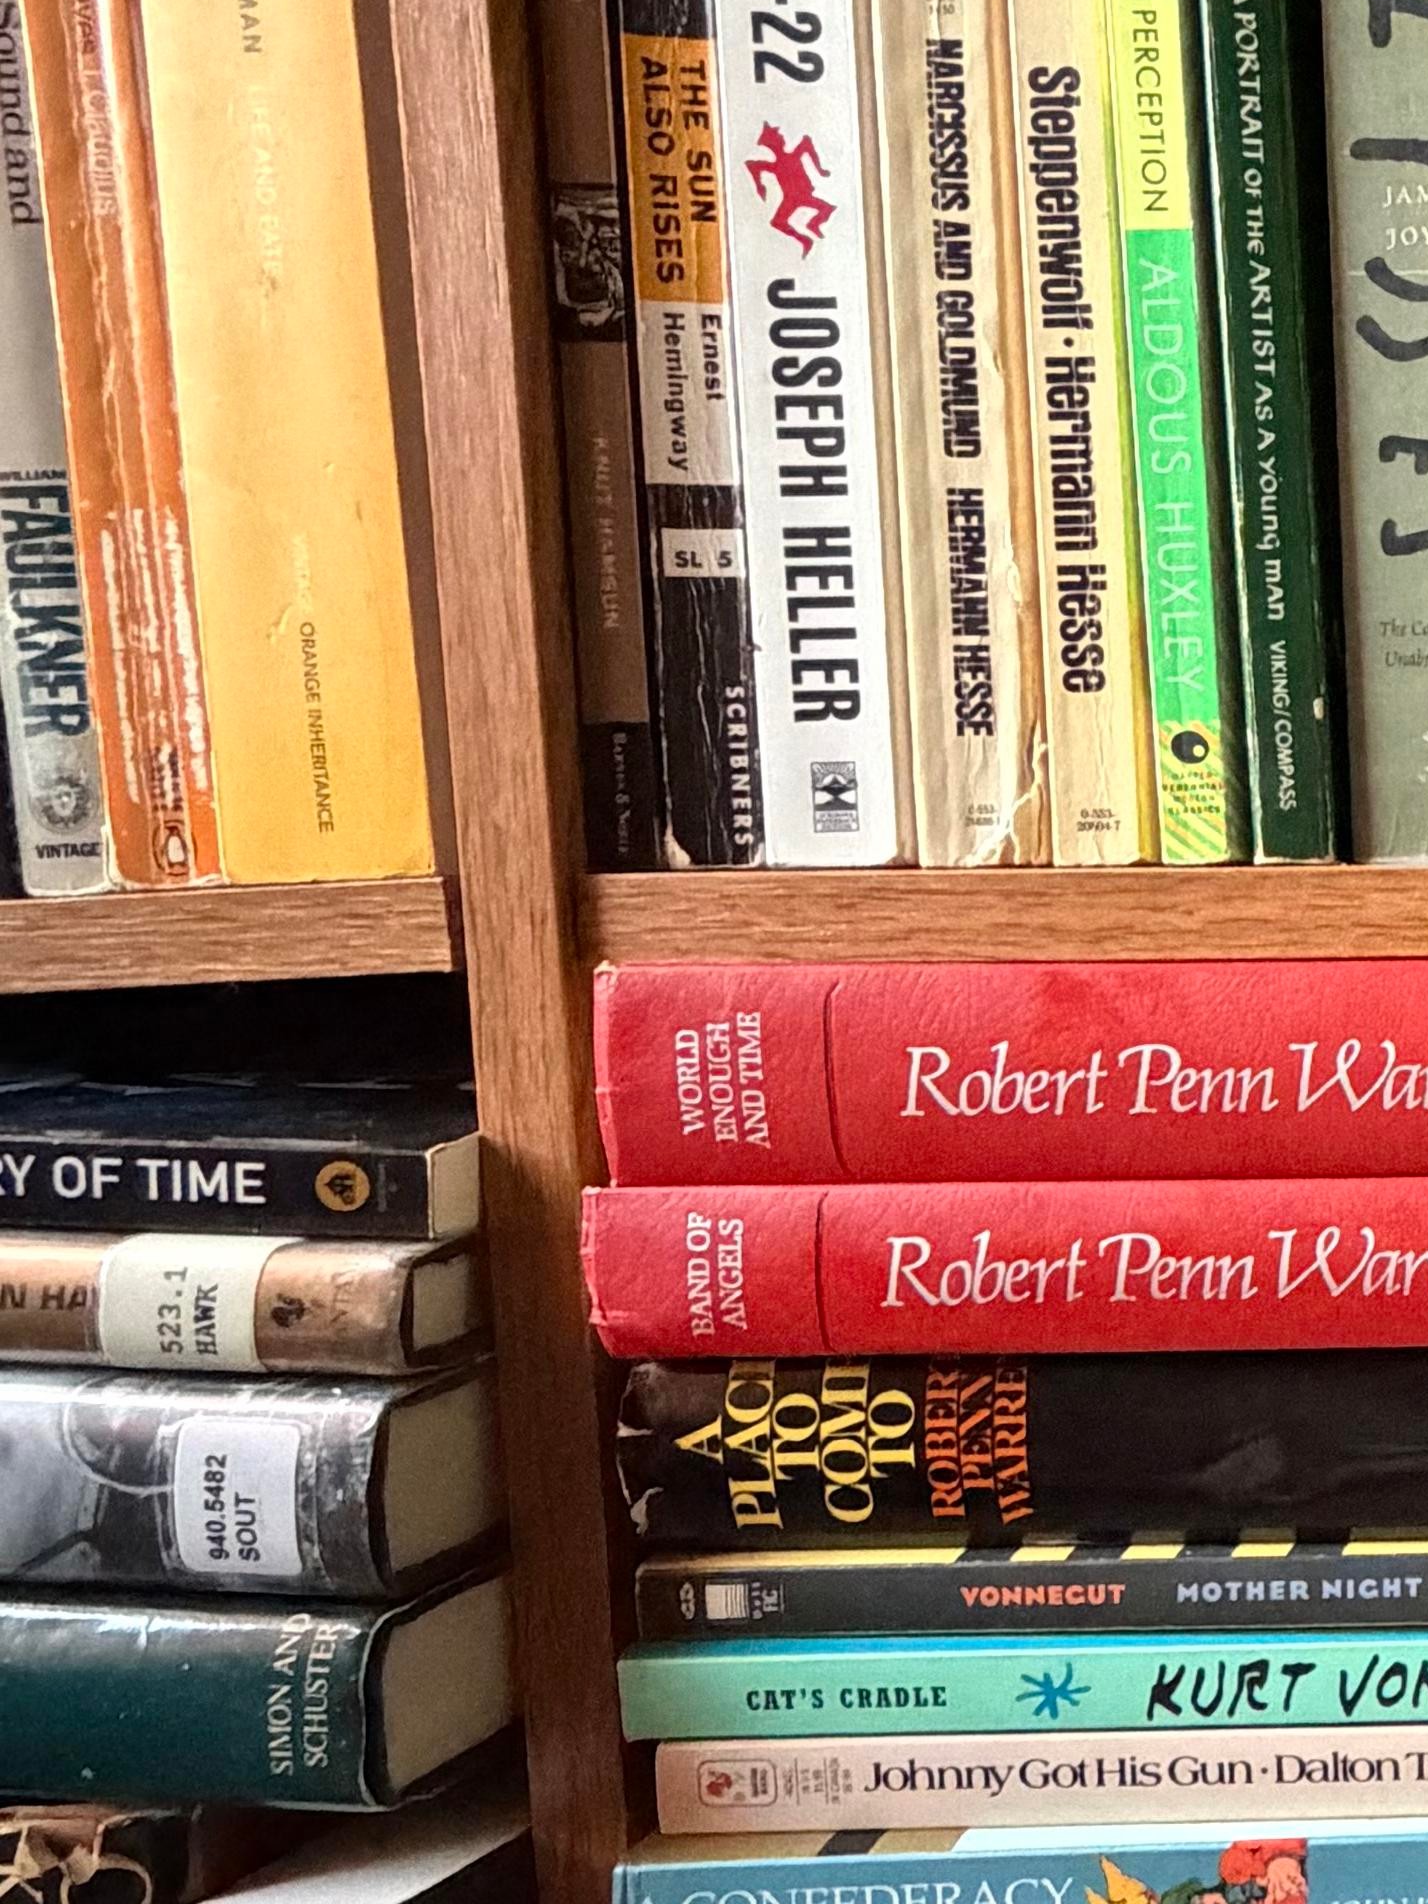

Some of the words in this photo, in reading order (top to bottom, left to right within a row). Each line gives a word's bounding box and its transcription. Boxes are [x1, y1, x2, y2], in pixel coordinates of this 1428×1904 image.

[1028, 67, 1093, 330] Steppenwolf
[661, 312, 688, 474] Hemingway
[700, 312, 724, 402] Ernest
[766, 277, 849, 498] JOSEPH
[1138, 258, 1192, 477] ALDOUS
[1045, 354, 1099, 555] Hermann
[3, 487, 89, 738] FAULKNER
[779, 525, 862, 724] HELLER
[1055, 563, 1107, 695] Hesse
[1152, 499, 1205, 692] HUXLEY
[724, 684, 754, 848] SCRIBNERS
[900, 1040, 1109, 1117] Robert
[1115, 1040, 1276, 1117] Penn
[52, 1159, 124, 1202] OF
[137, 1159, 267, 1206] TIME
[159, 1265, 189, 1356] 523.1
[880, 1229, 1088, 1306] Robert
[1097, 1229, 1254, 1305] Penn
[193, 1282, 218, 1357] HAWK
[208, 1452, 228, 1562] 940.5482
[237, 1491, 260, 1562] SOUT
[960, 1582, 1125, 1608] VONNEGUT
[1177, 1579, 1312, 1603] MOTHER
[1323, 1575, 1423, 1602] NIGHT
[746, 1687, 826, 1711] CAT'S
[839, 1684, 948, 1710] CRADLE
[1148, 1660, 1310, 1719] KURT
[863, 1751, 1013, 1796] Johnny
[1017, 1749, 1090, 1790] Got
[1094, 1748, 1160, 1788] His
[1167, 1748, 1253, 1787] Gun
[1274, 1746, 1397, 1786] Dalton
